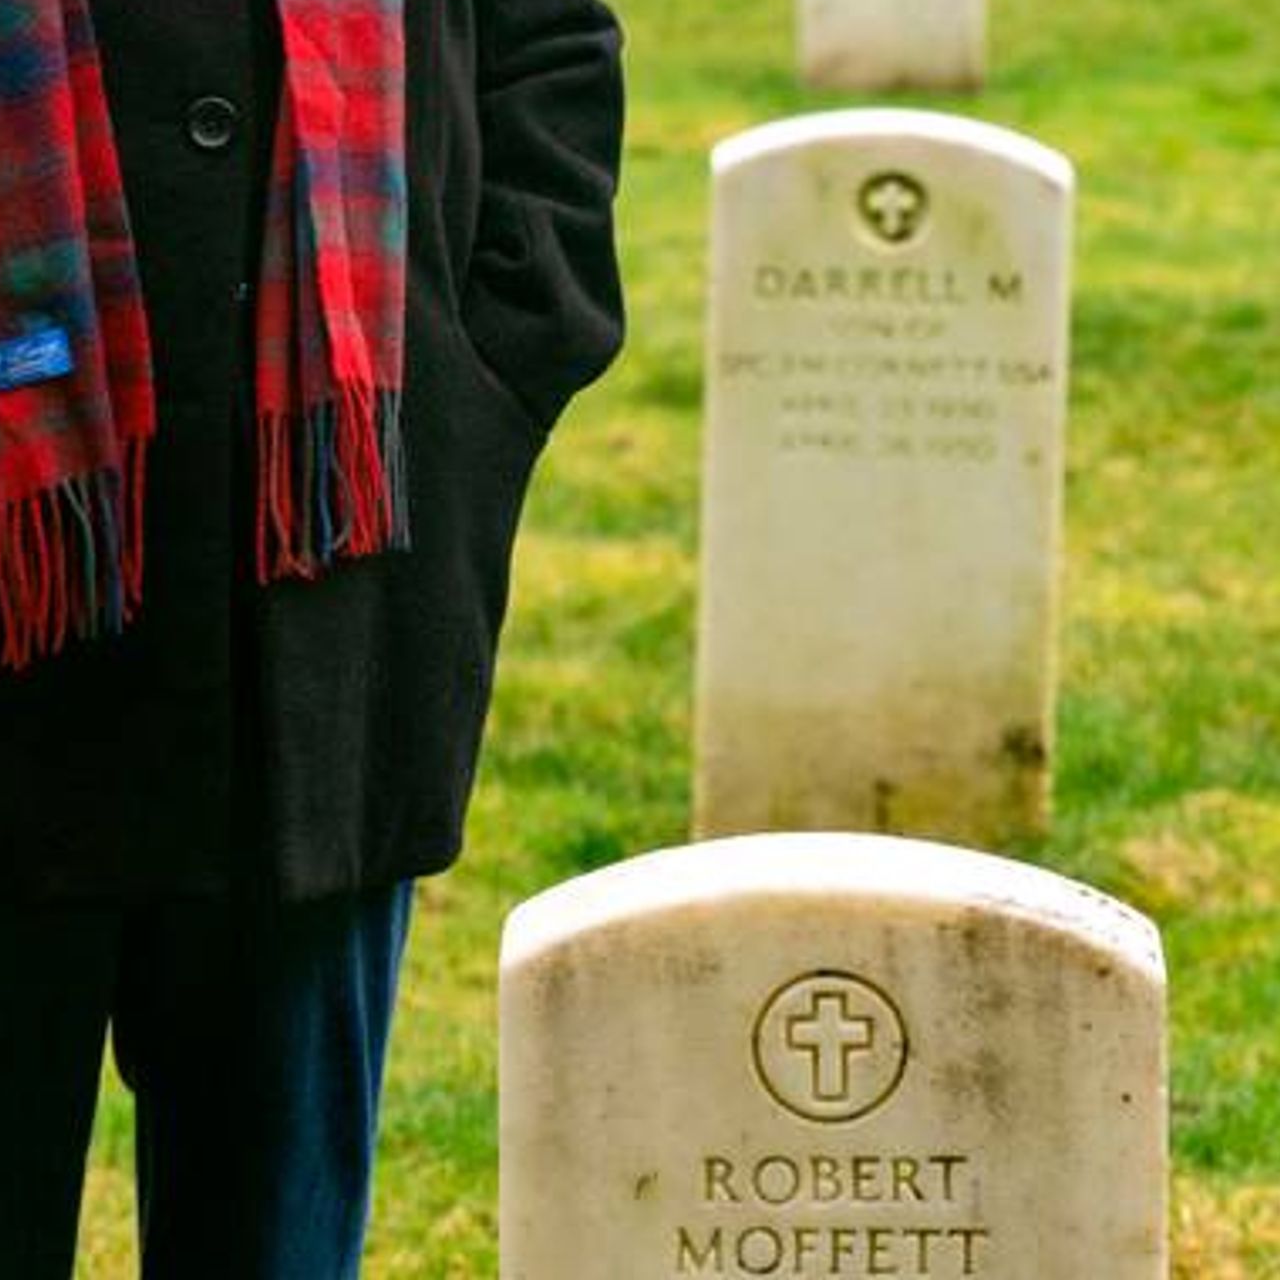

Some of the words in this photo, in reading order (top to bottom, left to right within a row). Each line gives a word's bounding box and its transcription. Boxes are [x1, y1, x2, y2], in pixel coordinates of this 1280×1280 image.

[754, 265, 967, 304] DARRELL
[987, 271, 1024, 306] M
[701, 1153, 970, 1206] ROBERT
[674, 1224, 992, 1277] MOFFETT
